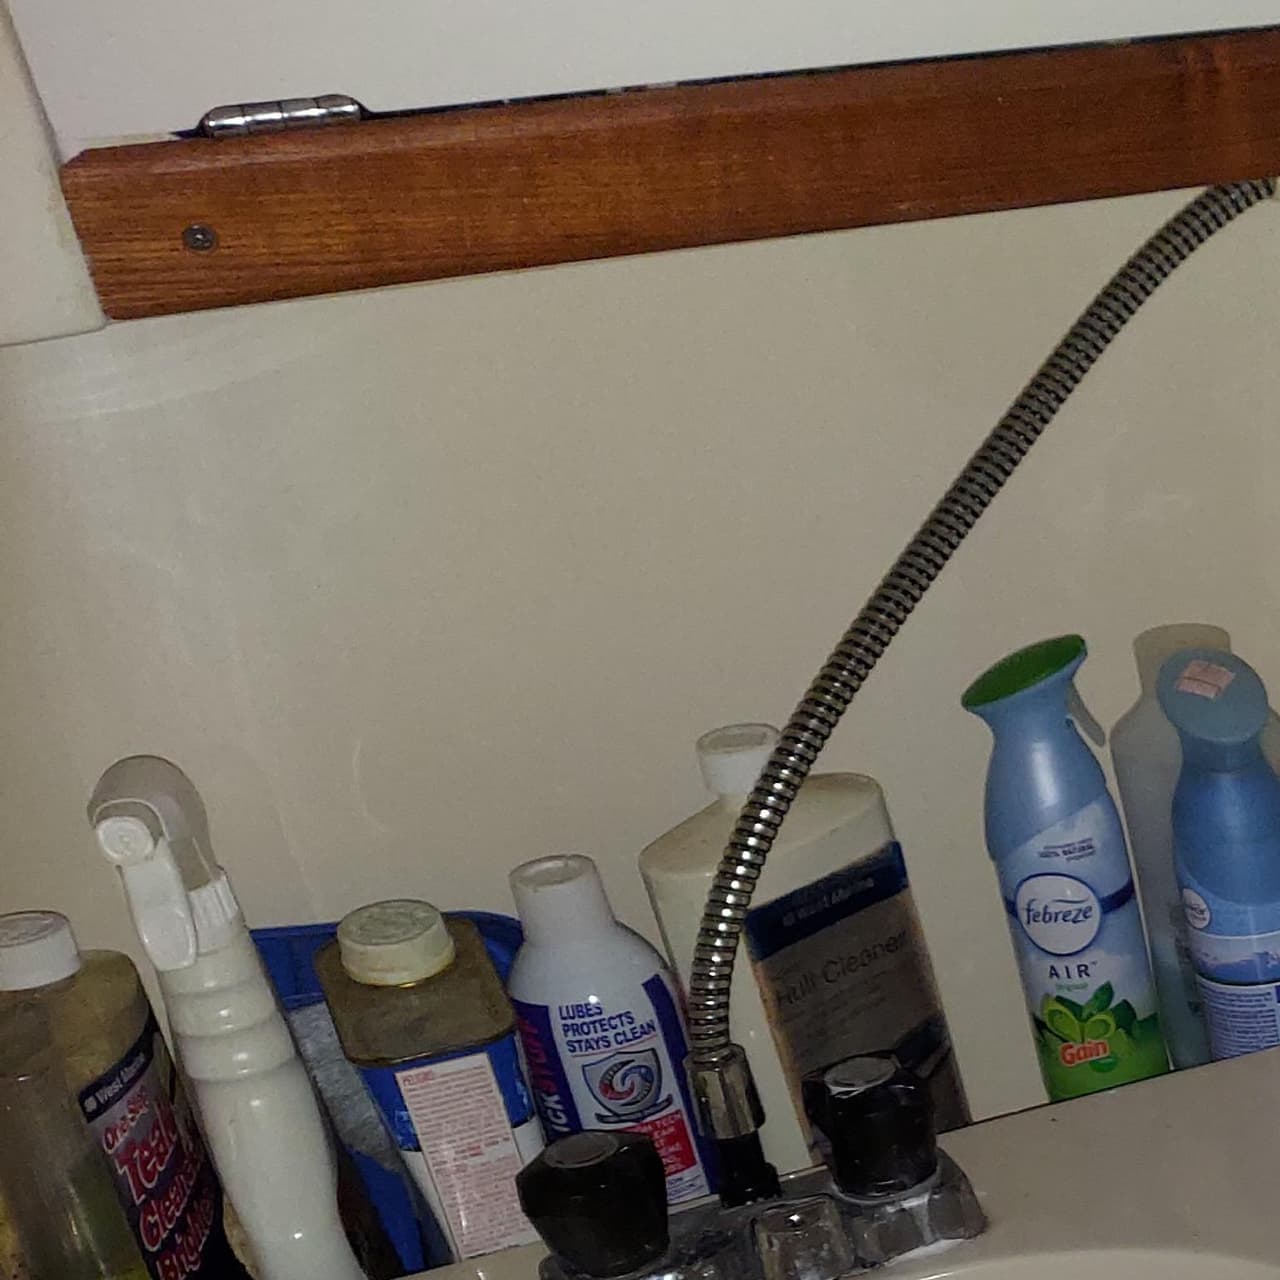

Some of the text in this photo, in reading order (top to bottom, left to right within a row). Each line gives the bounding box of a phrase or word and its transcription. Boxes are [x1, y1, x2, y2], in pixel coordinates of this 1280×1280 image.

[1026, 898, 1093, 925] febreze
[822, 930, 907, 984] Cleaner
[558, 1001, 602, 1020] LUBES
[562, 1011, 635, 1037] PROTECTS
[566, 1019, 656, 1053] STAYS CLEAN
[1060, 1041, 1108, 1066] Gain
[114, 1101, 178, 1206] Teak
